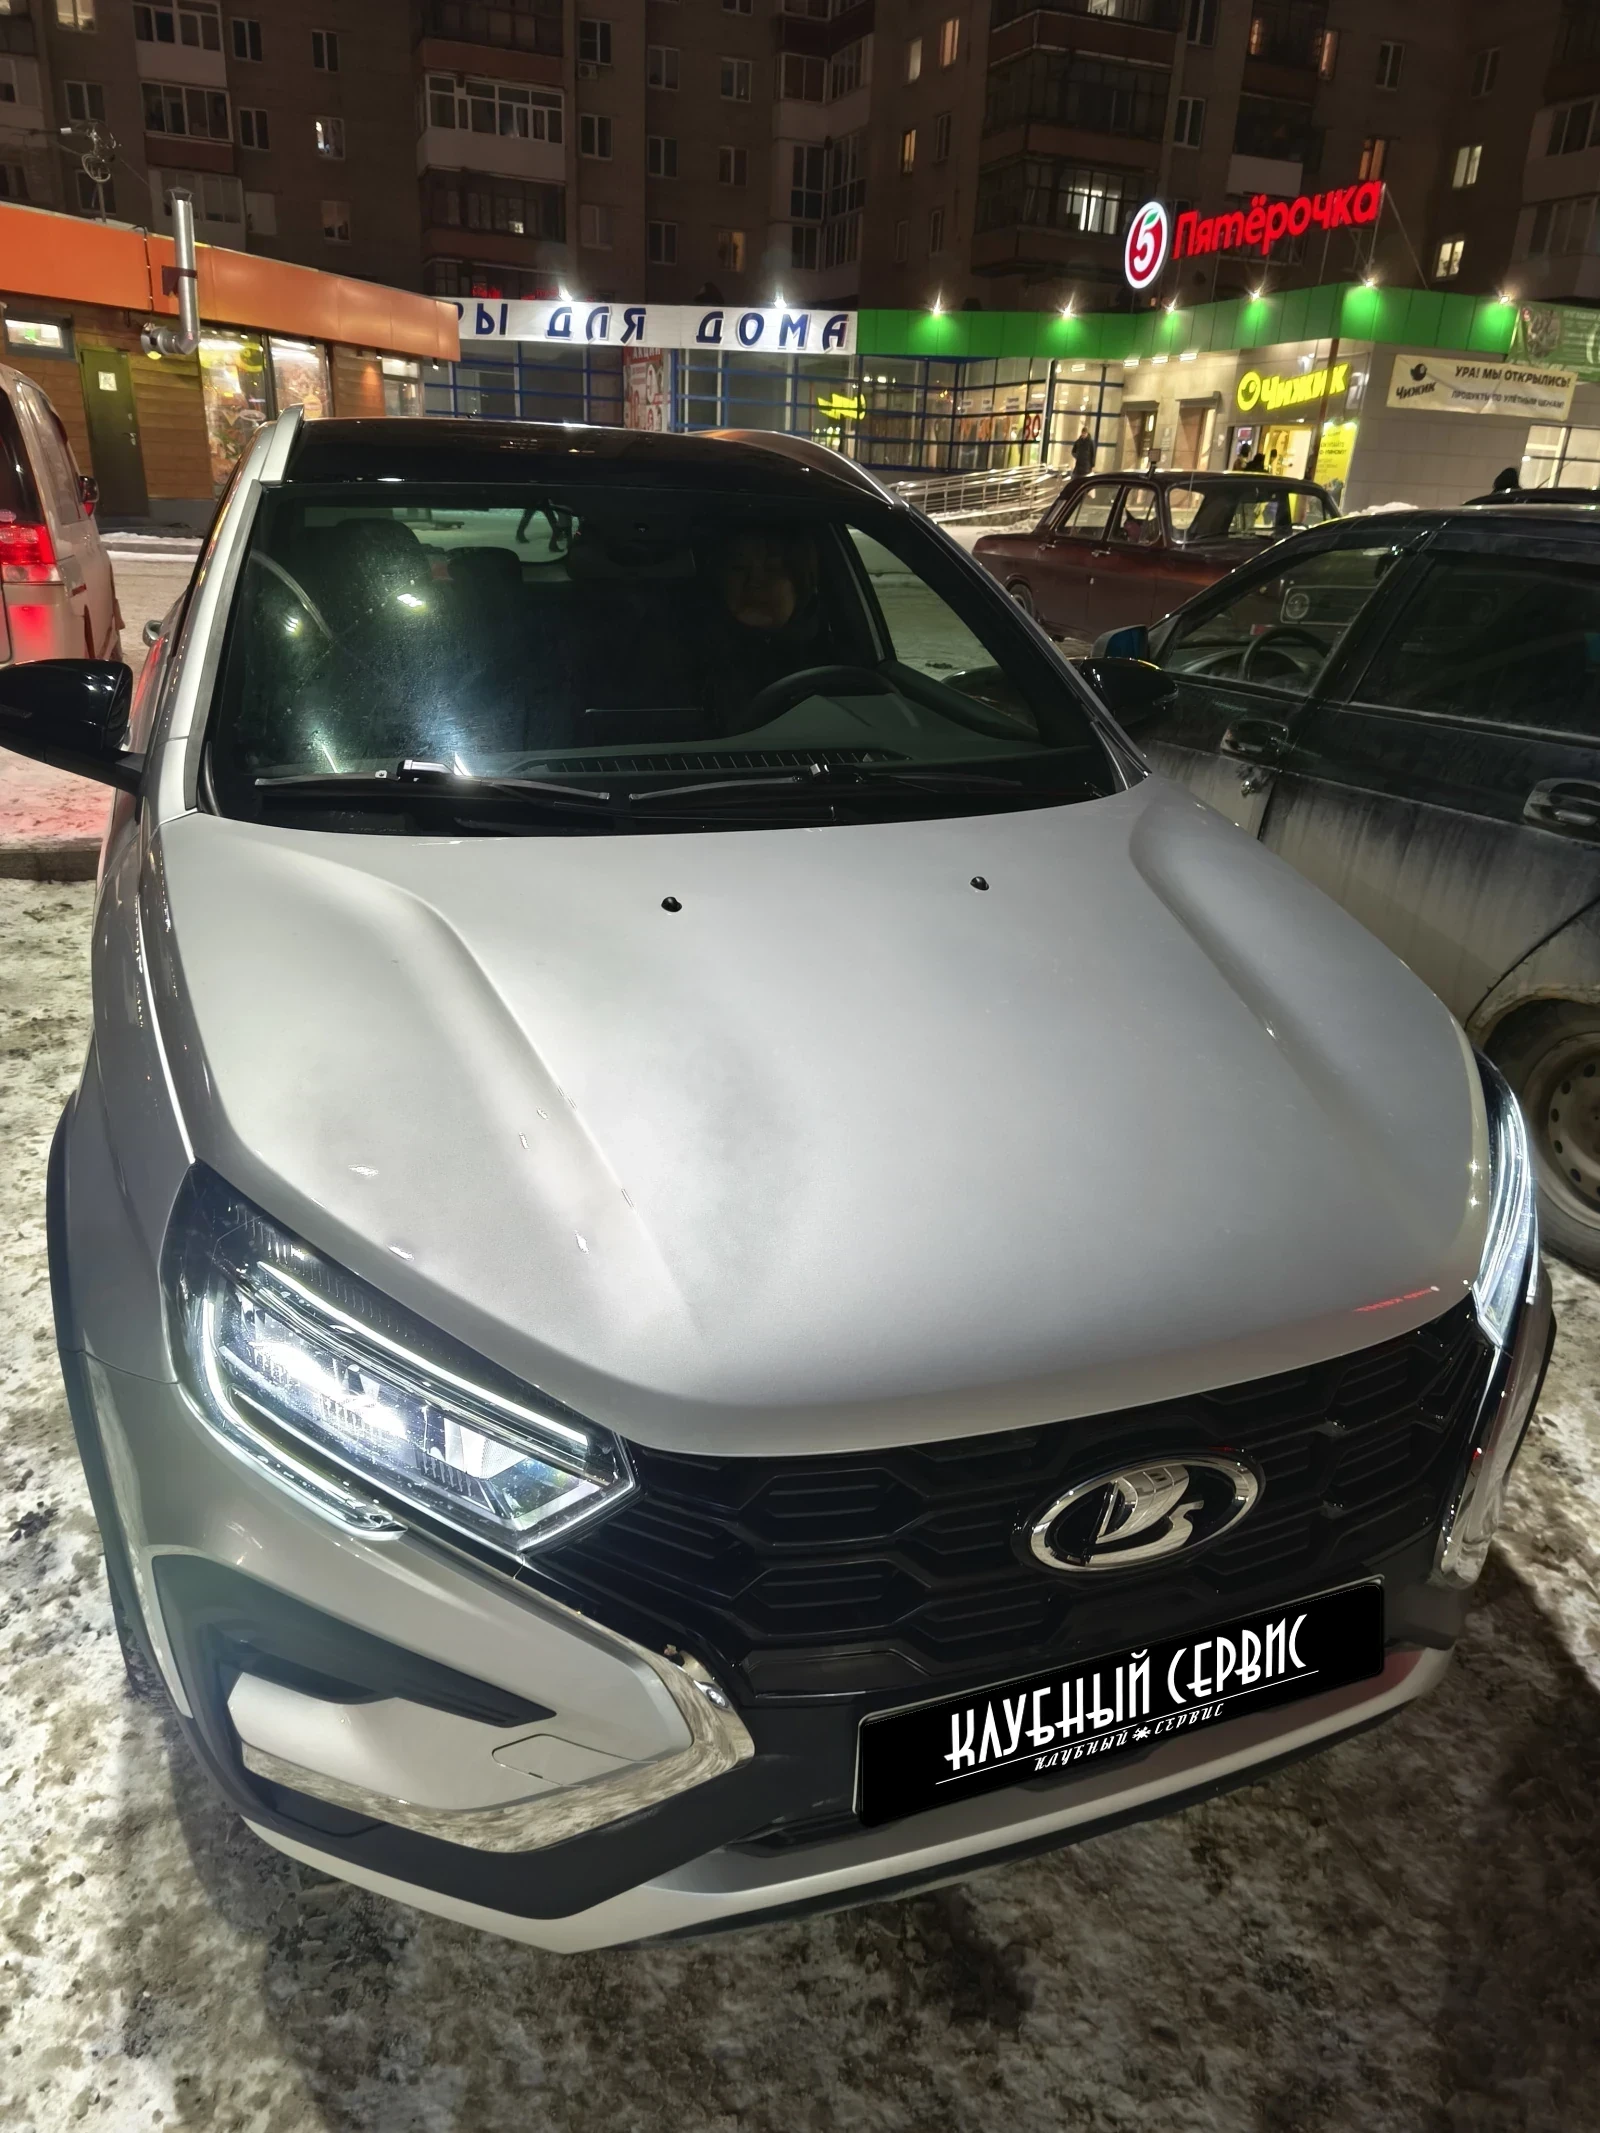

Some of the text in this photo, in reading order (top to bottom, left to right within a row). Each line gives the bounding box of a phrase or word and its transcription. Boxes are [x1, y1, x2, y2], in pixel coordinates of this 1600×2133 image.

[1172, 180, 1382, 260] Пятёрочка
[457, 301, 850, 352] Ы ДЛЯ ДОМА
[1455, 366, 1480, 379] УРА!
[1482, 367, 1502, 380] МЫ
[1504, 369, 1572, 388] ОТКРЫЛИСЬ!
